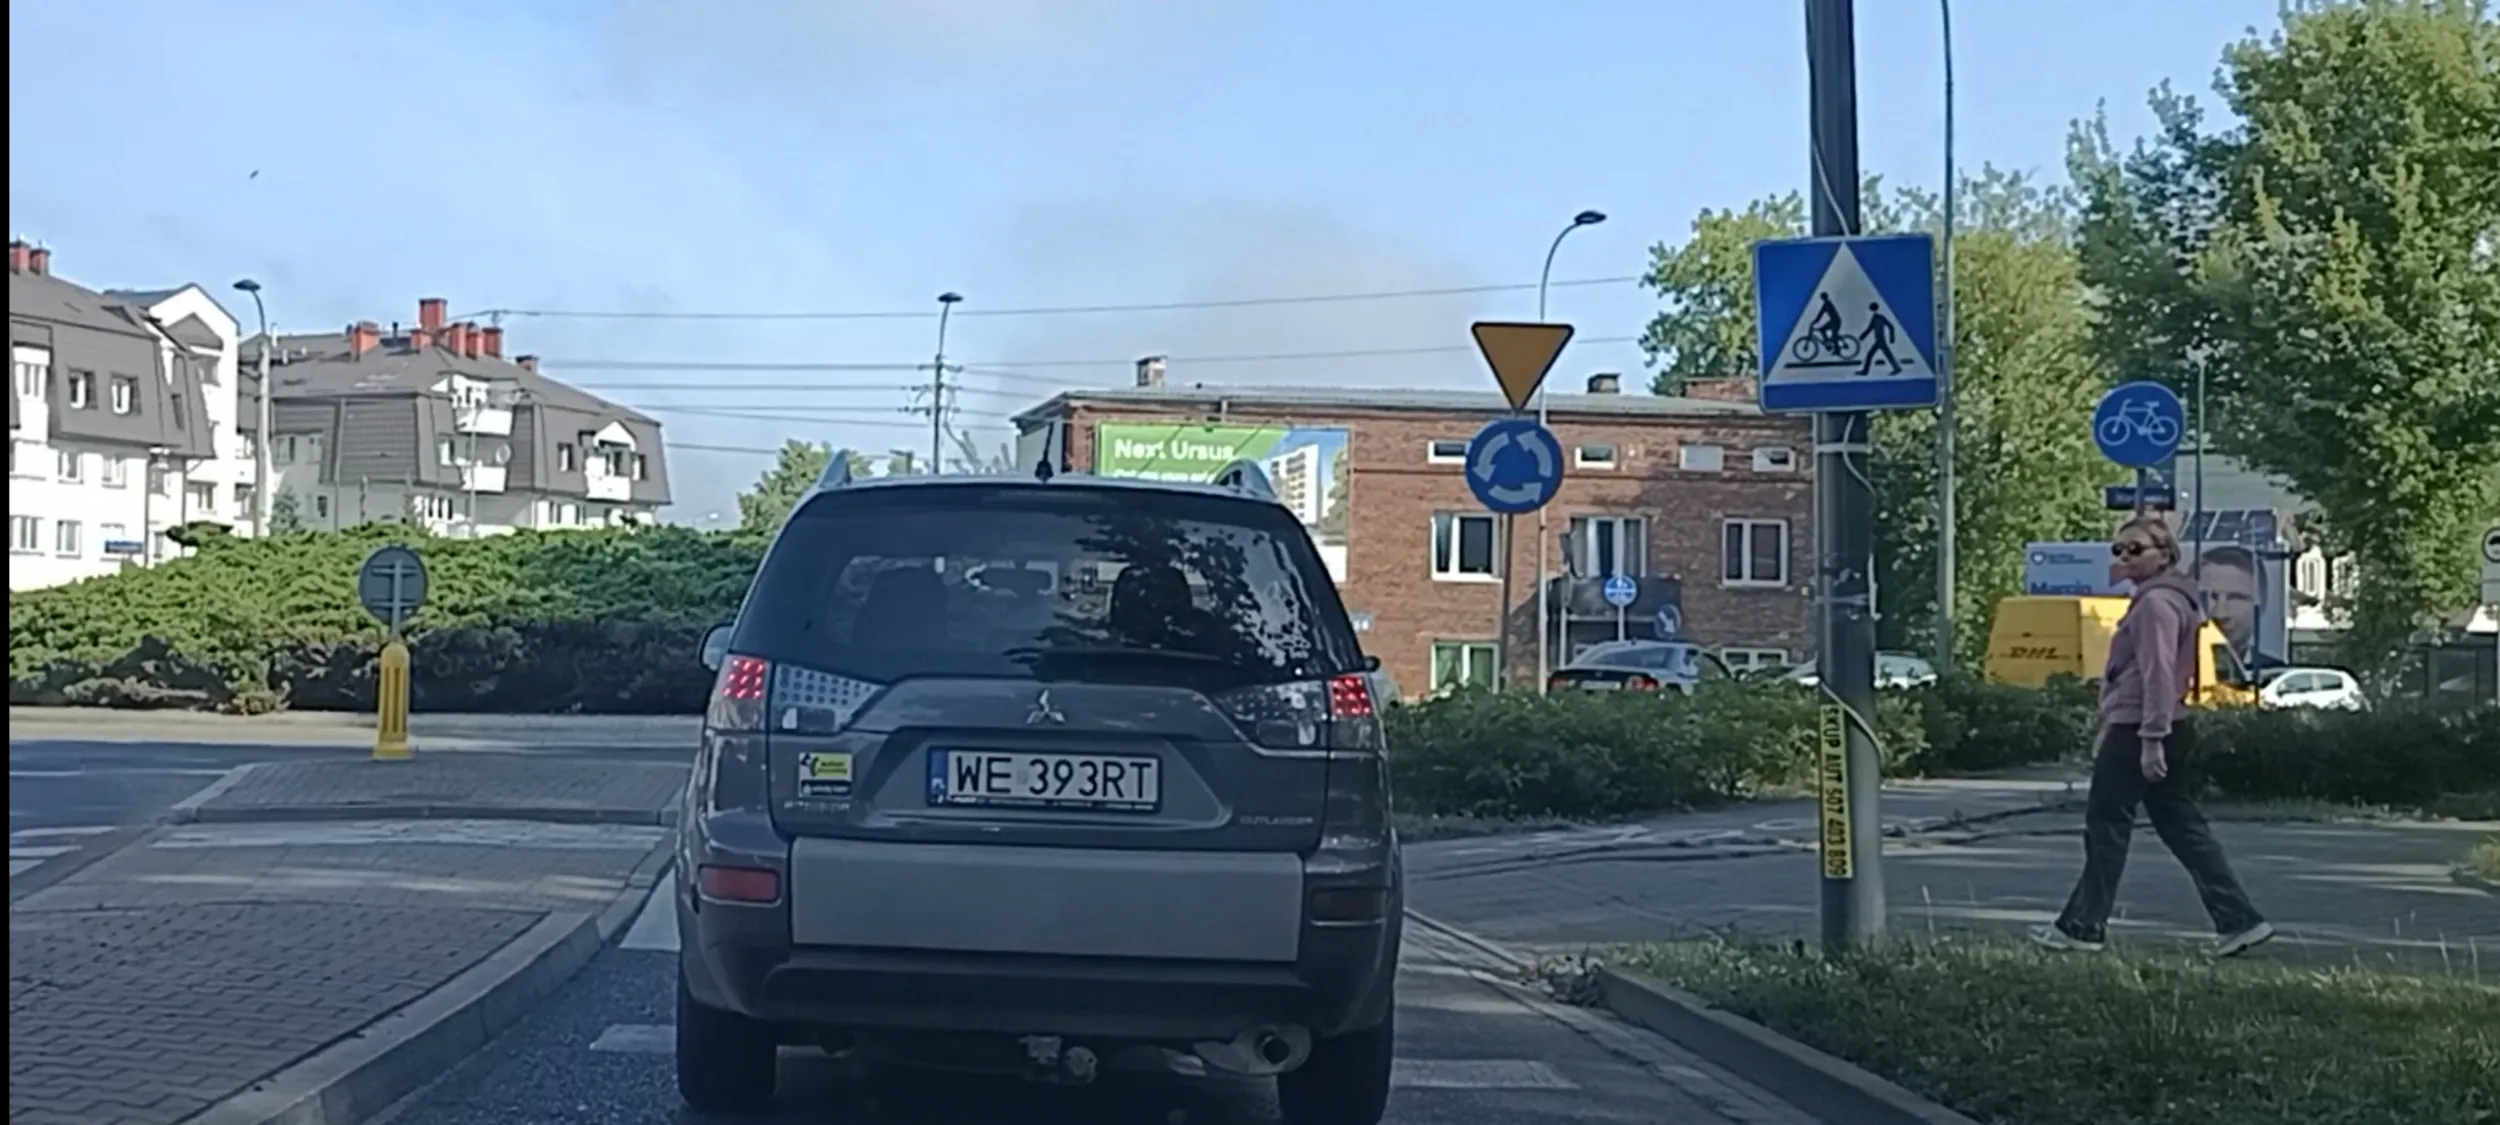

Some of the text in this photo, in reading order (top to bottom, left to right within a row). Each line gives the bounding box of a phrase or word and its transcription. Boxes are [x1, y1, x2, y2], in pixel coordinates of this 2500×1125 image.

[1114, 438, 1234, 460] Next Ursus
[2010, 646, 2057, 660] DHL
[1823, 707, 1841, 748] SKUP
[956, 755, 1153, 799] WE 393RT
[1825, 754, 1843, 784] AUT
[1826, 788, 1845, 815] 507
